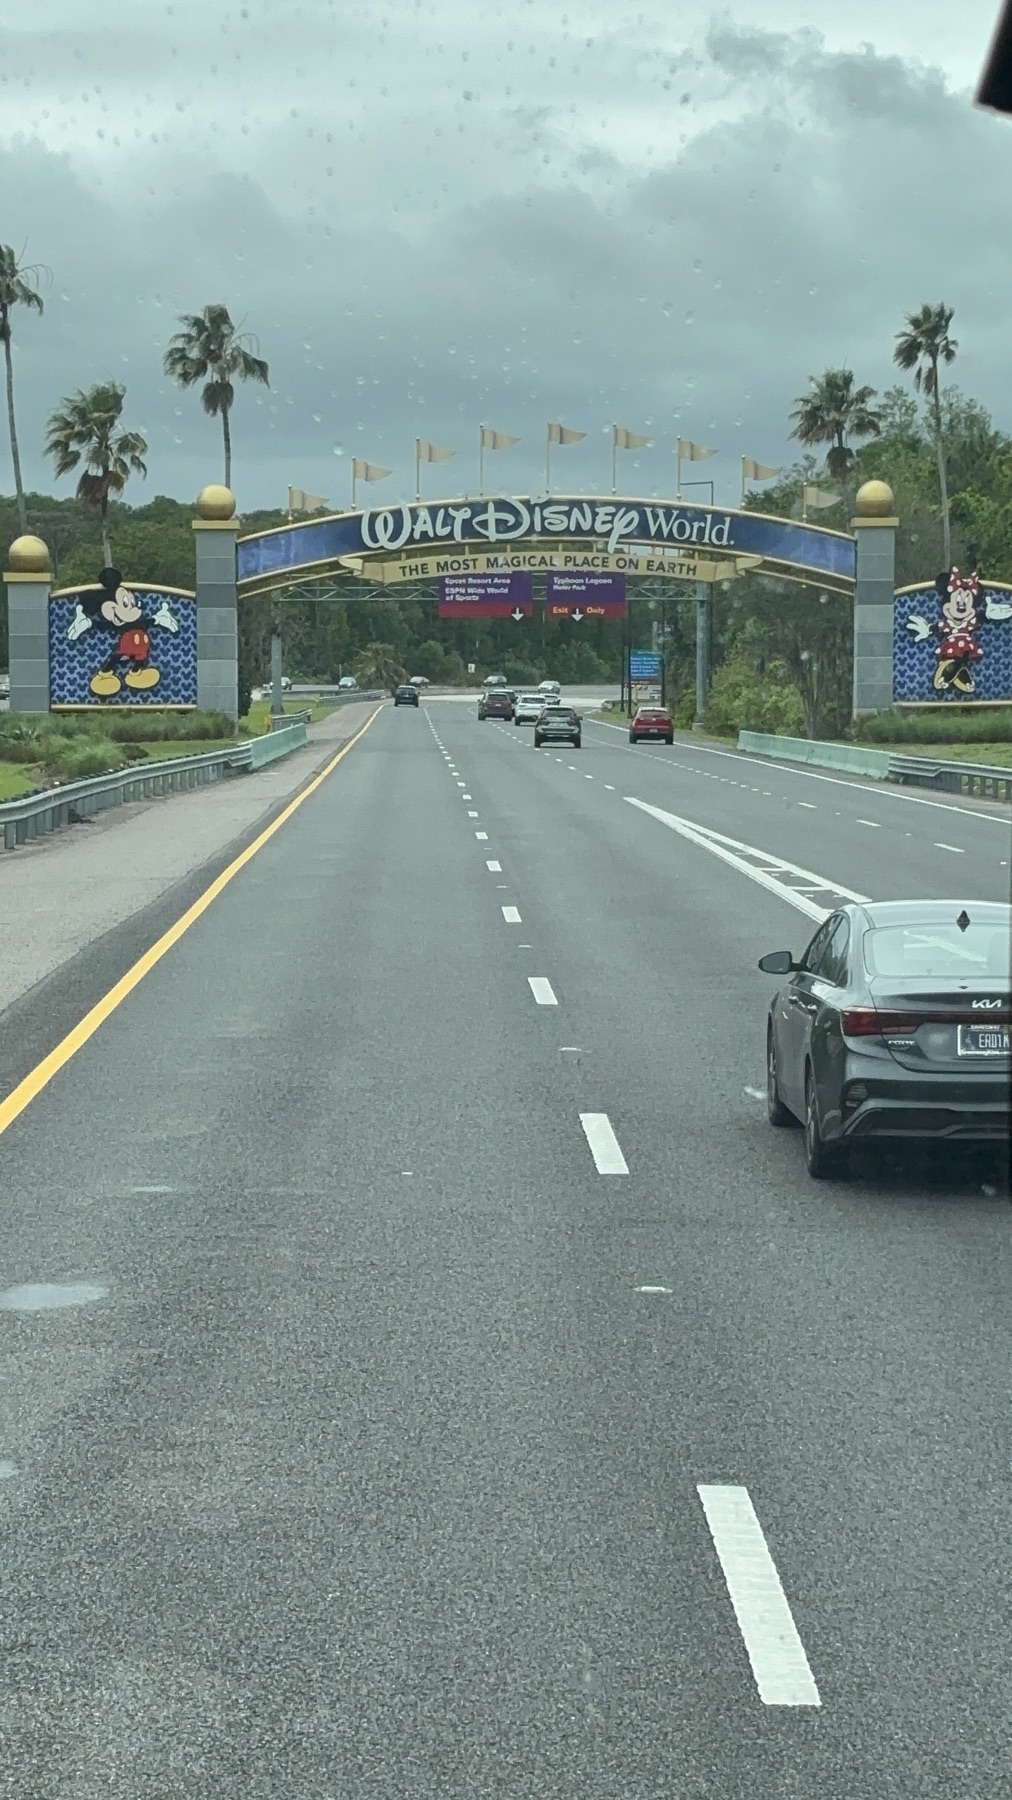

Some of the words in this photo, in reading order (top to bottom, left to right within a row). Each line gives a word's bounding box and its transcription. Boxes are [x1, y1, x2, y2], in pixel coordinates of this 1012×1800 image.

[399, 562, 429, 578] THE
[436, 558, 479, 573] MOST
[486, 555, 557, 569] MAGICAL
[564, 555, 609, 568] PLACE
[615, 557, 639, 570] ON
[646, 559, 698, 577] EARTH
[552, 606, 569, 614] Exit
[586, 606, 606, 615] Only
